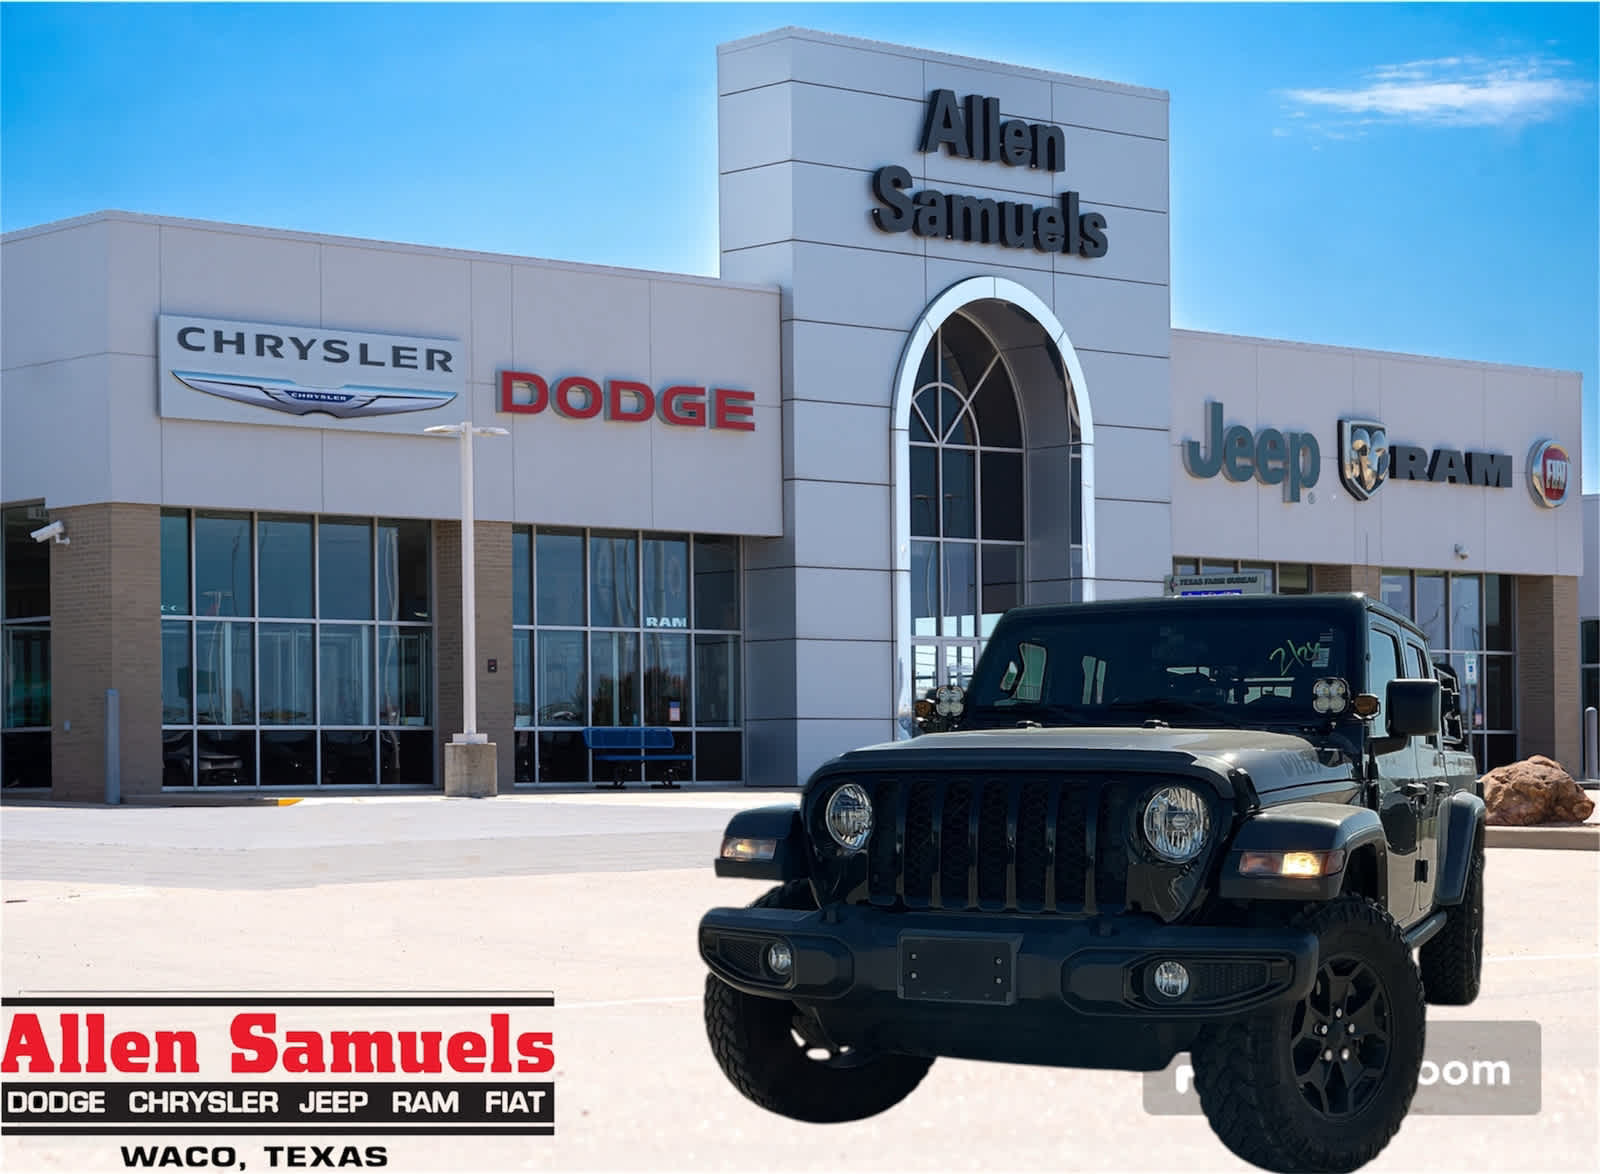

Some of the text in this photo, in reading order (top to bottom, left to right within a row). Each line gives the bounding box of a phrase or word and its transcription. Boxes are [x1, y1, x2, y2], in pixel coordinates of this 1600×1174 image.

[918, 88, 1066, 172] Allen
[872, 165, 1109, 258] Samuels
[177, 326, 453, 373] CHRYSLER
[291, 392, 347, 401] CHRYSLER
[496, 370, 755, 432] DODGE
[1183, 401, 1321, 503] Jeep
[1388, 445, 1513, 488] RAM
[646, 616, 688, 628] RAM
